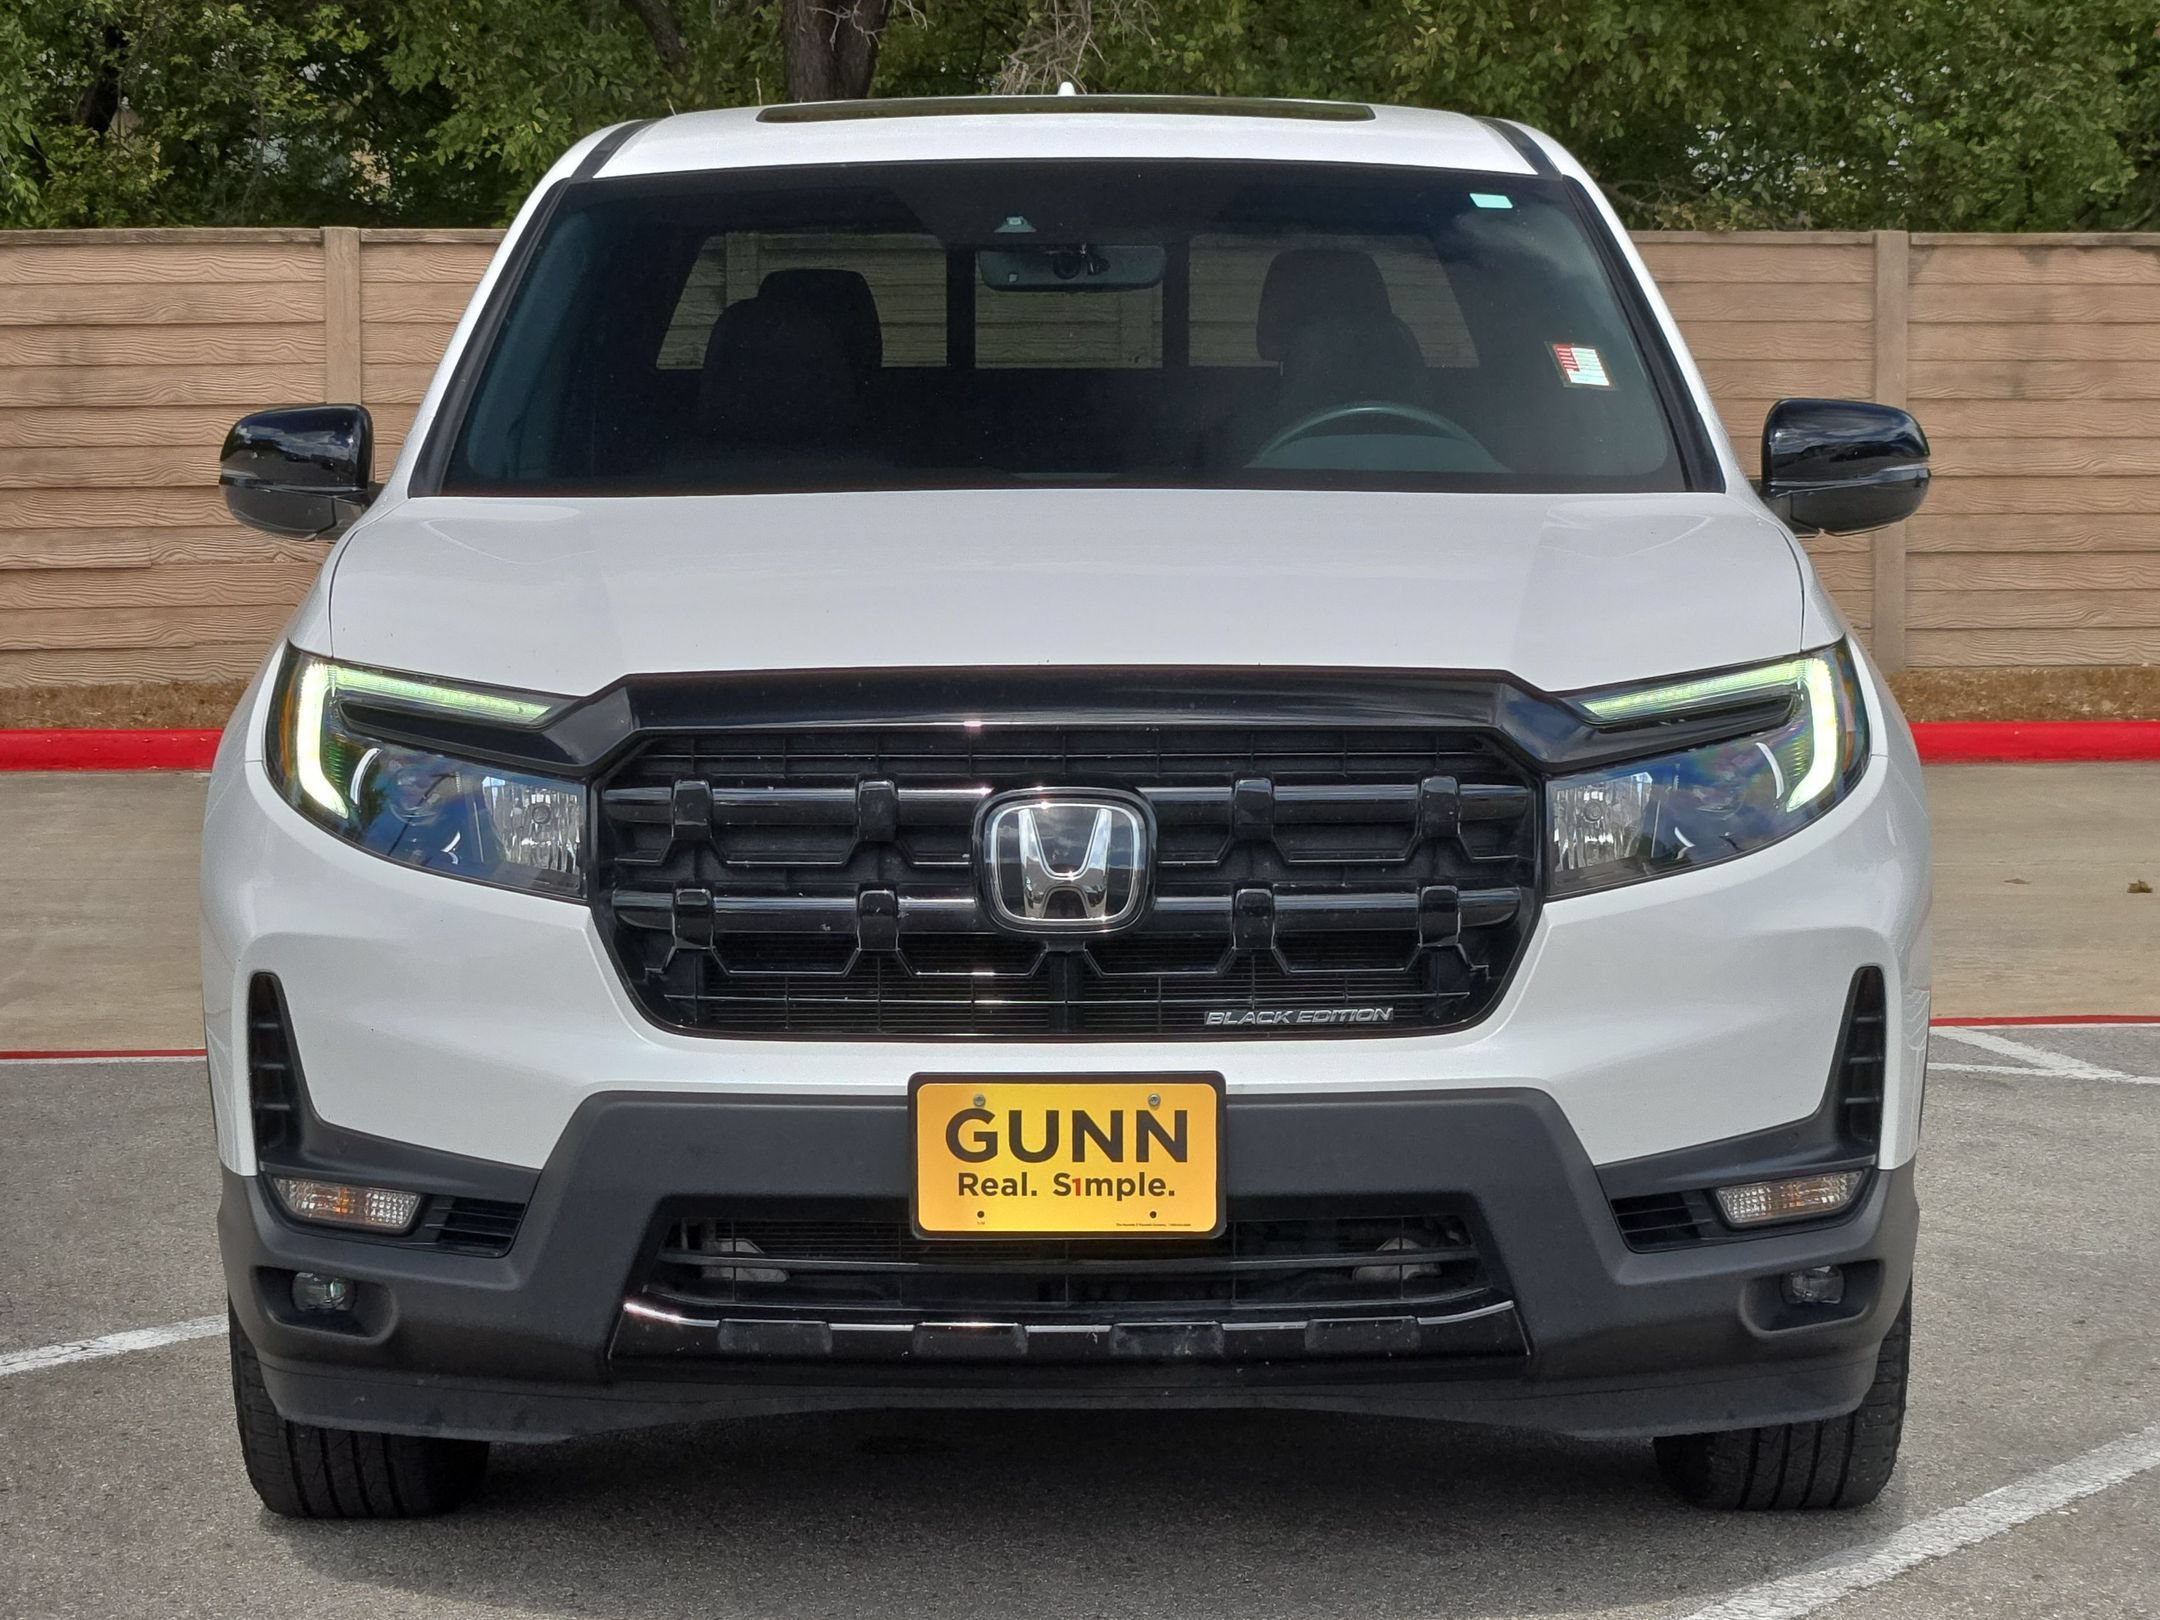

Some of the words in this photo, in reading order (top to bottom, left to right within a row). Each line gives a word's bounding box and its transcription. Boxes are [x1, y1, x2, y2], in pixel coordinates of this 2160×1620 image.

[1205, 1011, 1293, 1025] BLACK
[1296, 1007, 1393, 1024] EDITION
[945, 1108, 1188, 1163] GUNN
[958, 1171, 1038, 1197] Real.
